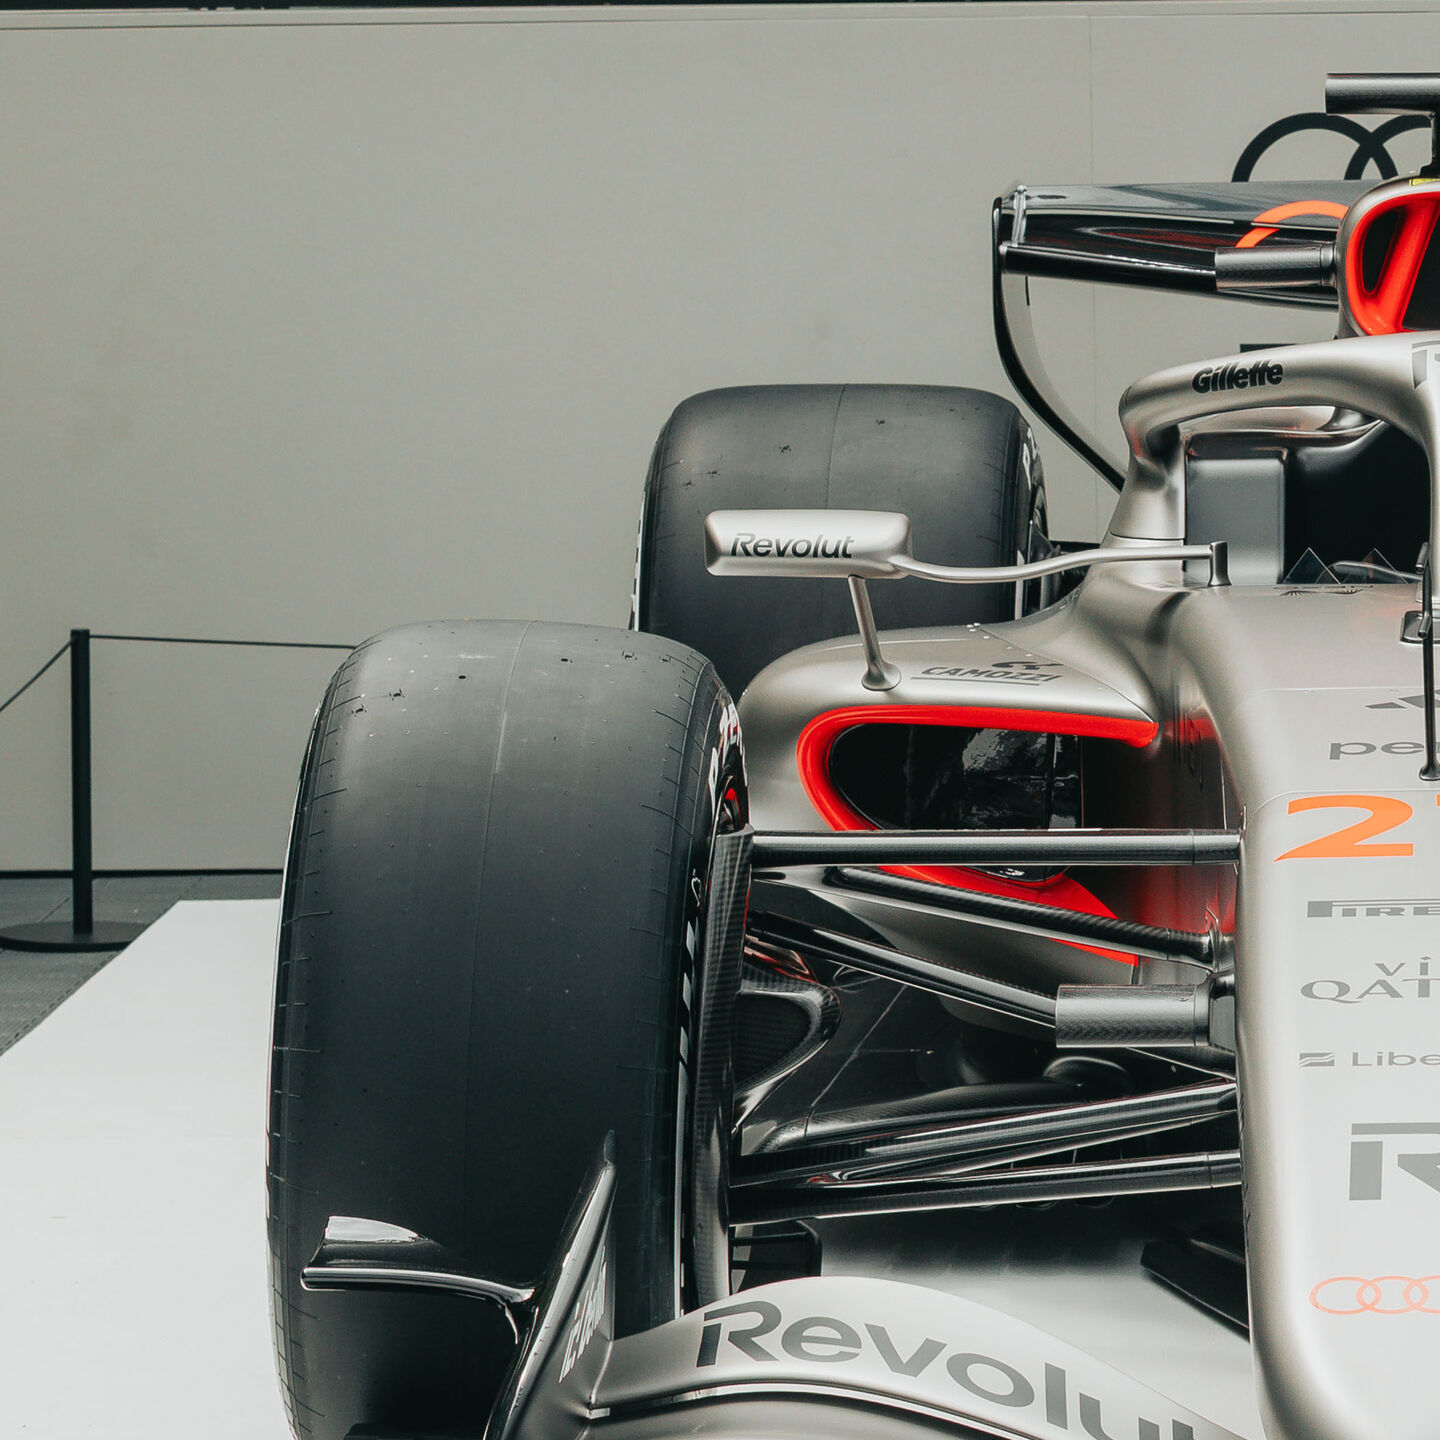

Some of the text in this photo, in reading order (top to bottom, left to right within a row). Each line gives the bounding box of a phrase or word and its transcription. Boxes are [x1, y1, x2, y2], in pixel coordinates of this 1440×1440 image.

[1192, 359, 1284, 393] Gillette
[731, 533, 855, 559] Revolut
[921, 666, 1063, 682] CAMOZZI
